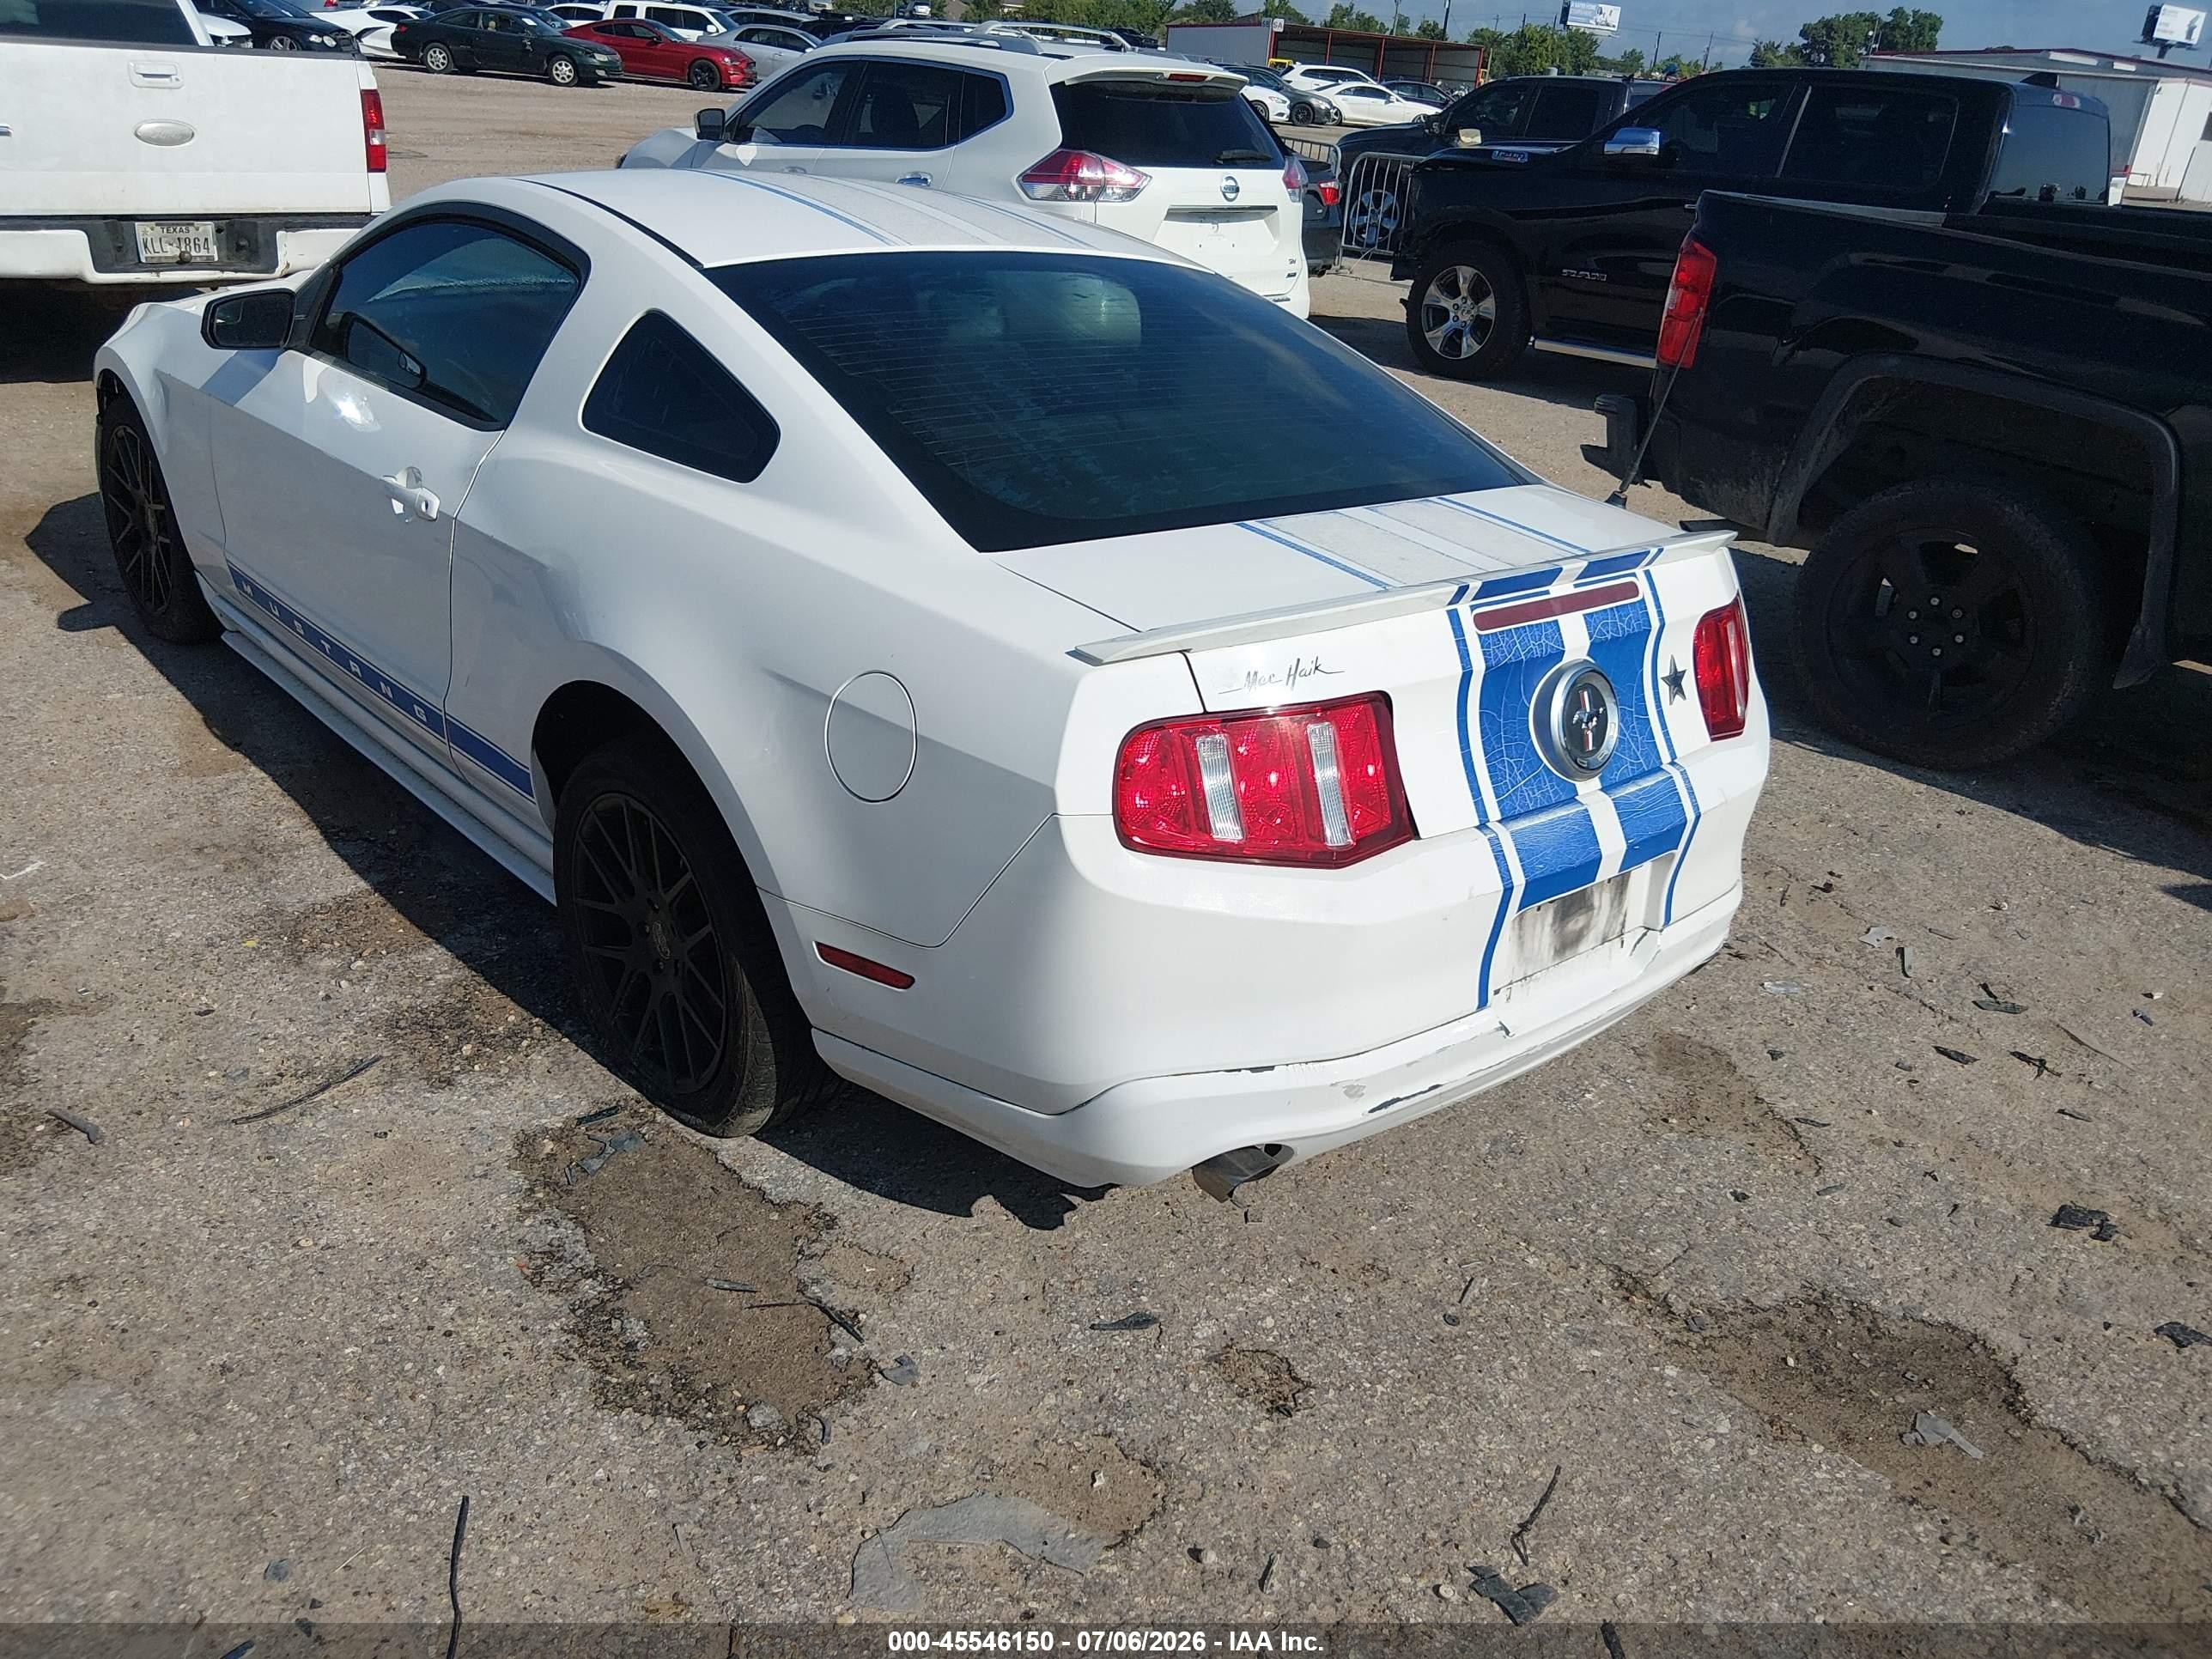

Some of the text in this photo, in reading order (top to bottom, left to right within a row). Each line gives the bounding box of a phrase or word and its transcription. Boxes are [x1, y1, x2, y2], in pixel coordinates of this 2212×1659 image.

[161, 226, 191, 234] TEXAS
[1560, 268, 1607, 282] RAM
[241, 580, 427, 723] MUSTANG
[1218, 655, 1346, 695] Mac Haik
